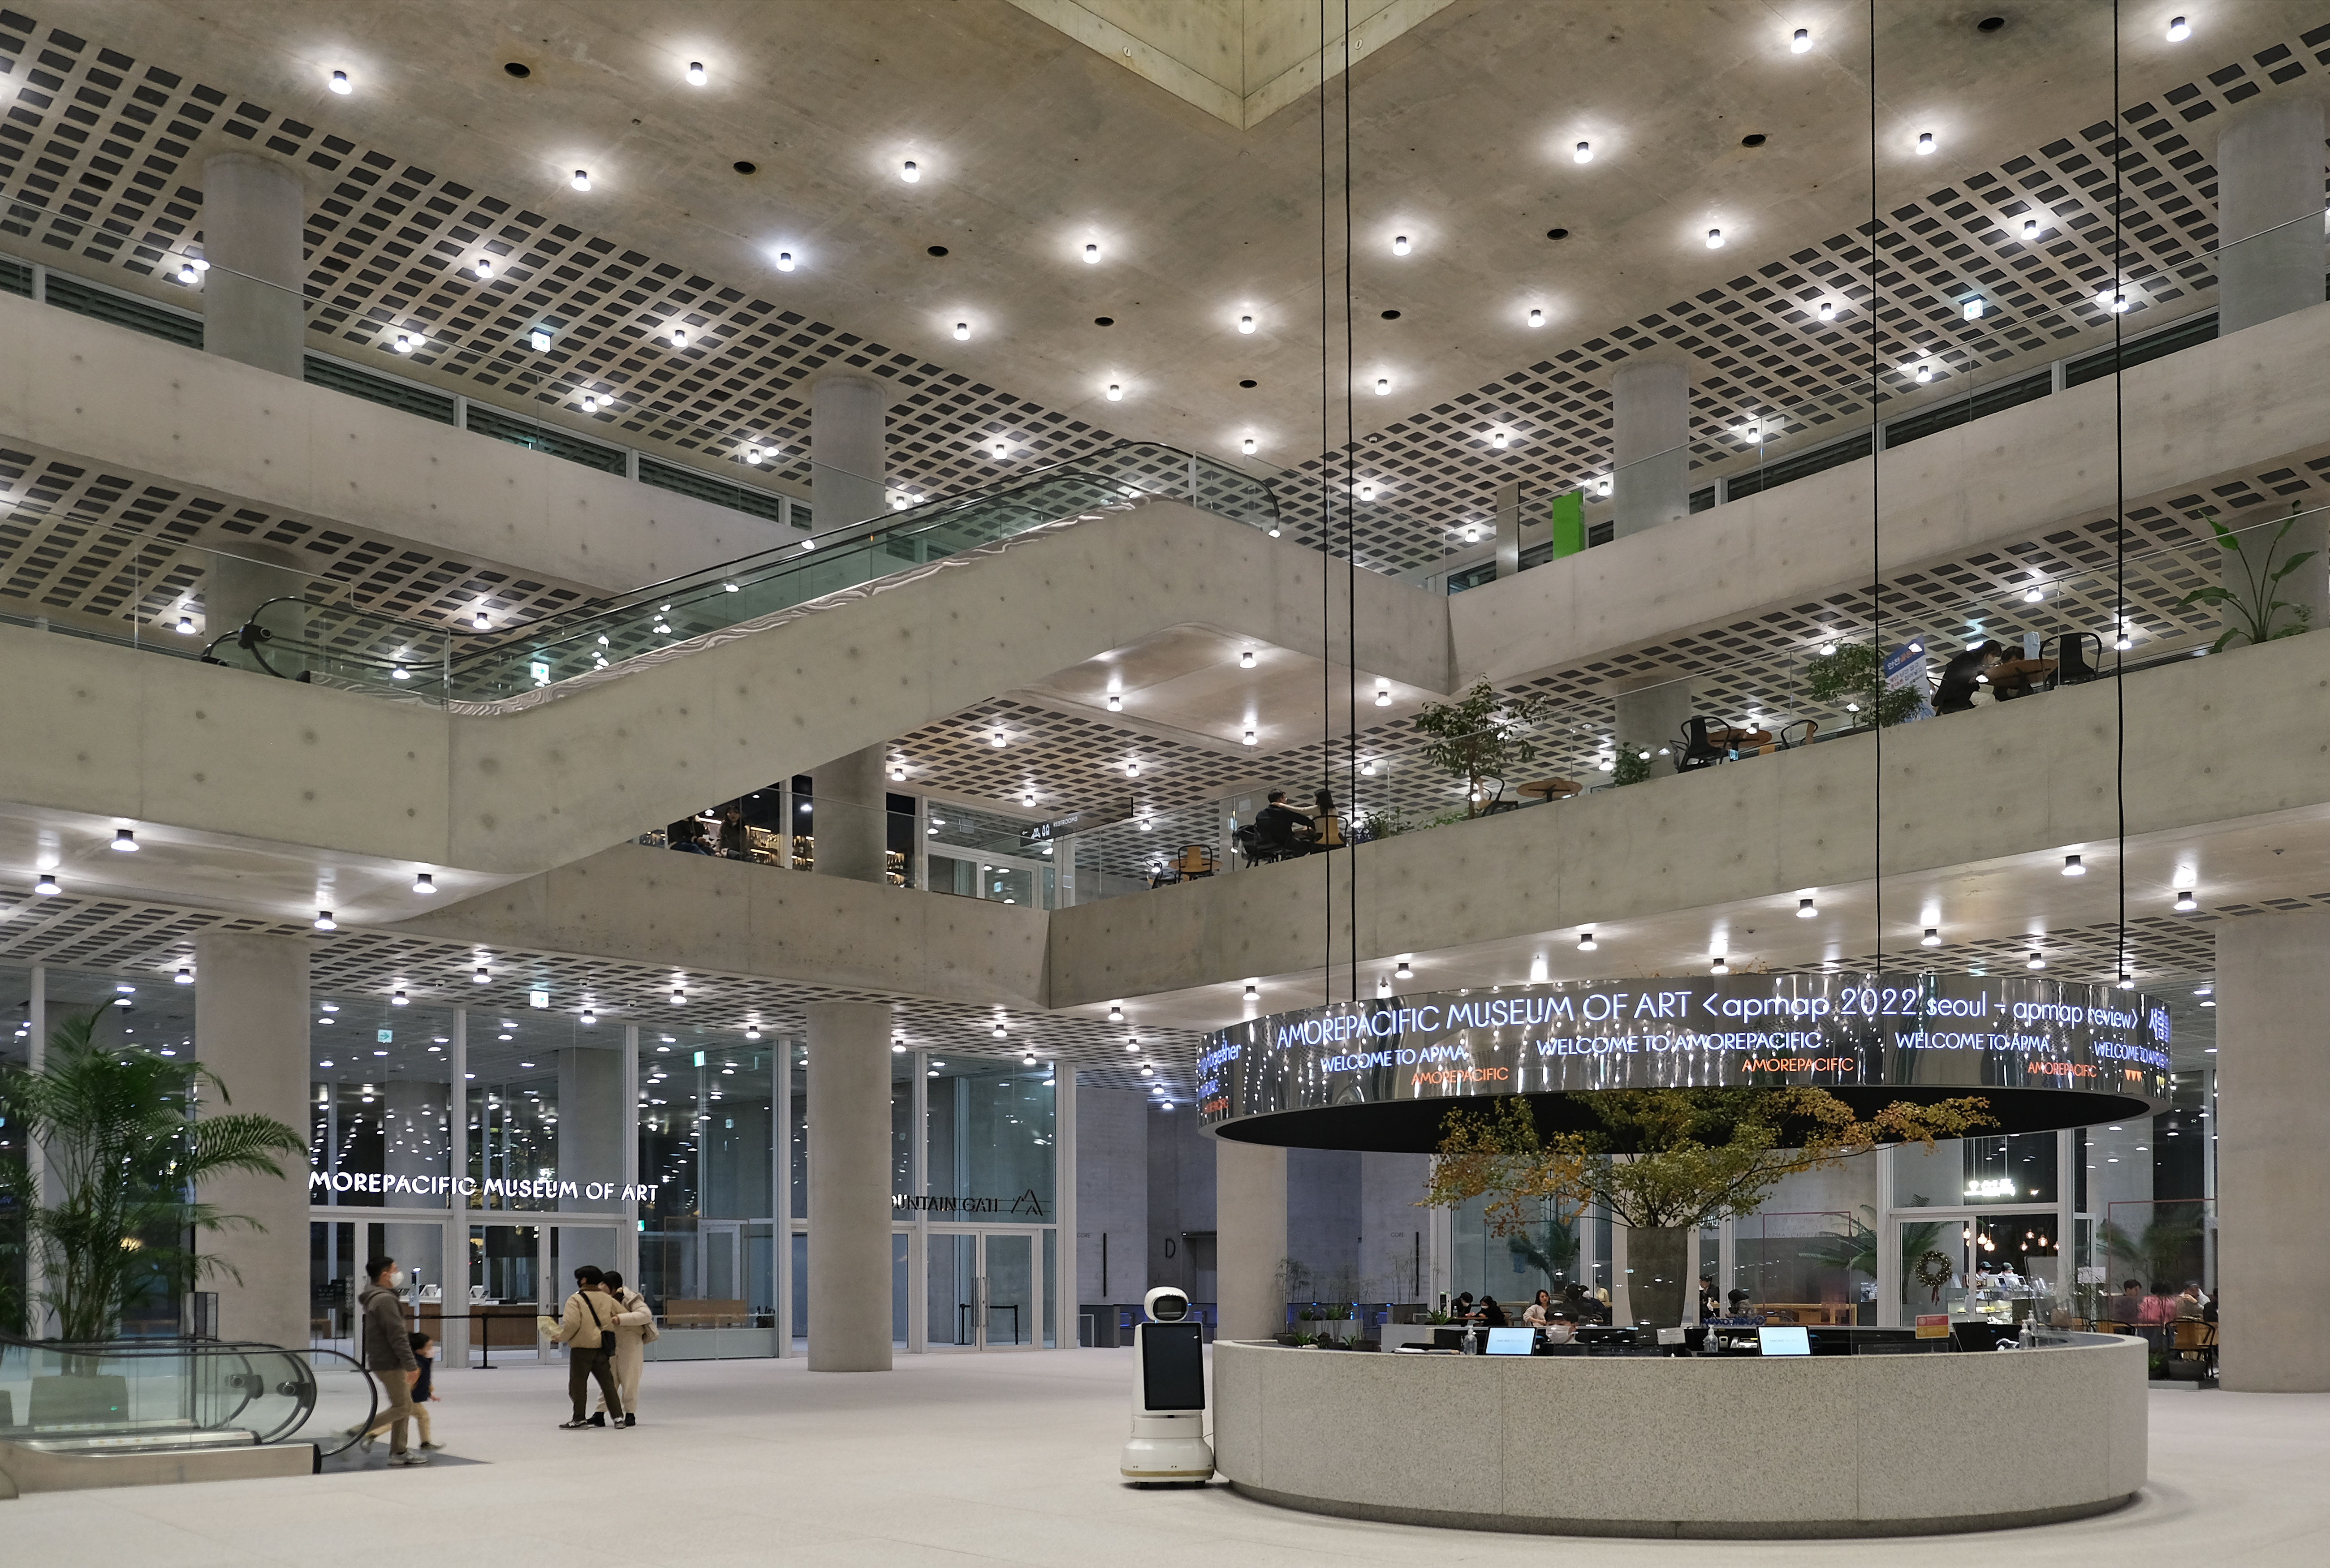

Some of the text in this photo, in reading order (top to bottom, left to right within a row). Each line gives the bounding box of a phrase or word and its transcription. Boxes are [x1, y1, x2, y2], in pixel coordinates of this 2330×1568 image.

[1053, 816, 1078, 827] RESTROOMS
[1276, 1005, 1440, 1050] AMOREPACIFIC
[1446, 996, 1575, 1030] MUSEUM
[1583, 993, 1628, 1021] OF
[1634, 991, 1692, 1019] ART
[1840, 988, 1916, 1015] 2022
[1926, 991, 1986, 1017] seoul
[2013, 1002, 2083, 1029] apmap
[1536, 1031, 1821, 1056] WELCOME TO AMOREPACIFIC
[1894, 1031, 2050, 1053] WELCOME TO APMA
[2093, 1040, 2140, 1062] WELCOME
[1320, 1044, 1467, 1073] WELCOME TO APMA
[1742, 1057, 1854, 1073] AMOREPACIFIC
[2027, 1061, 2098, 1078] AMOREPACIFIC
[1411, 1067, 1509, 1086] AMOREPACIFIC
[483, 1178, 578, 1199] MUSEUM
[585, 1182, 615, 1200] OF
[621, 1184, 659, 1202] ART
[1165, 1238, 1176, 1259] D
